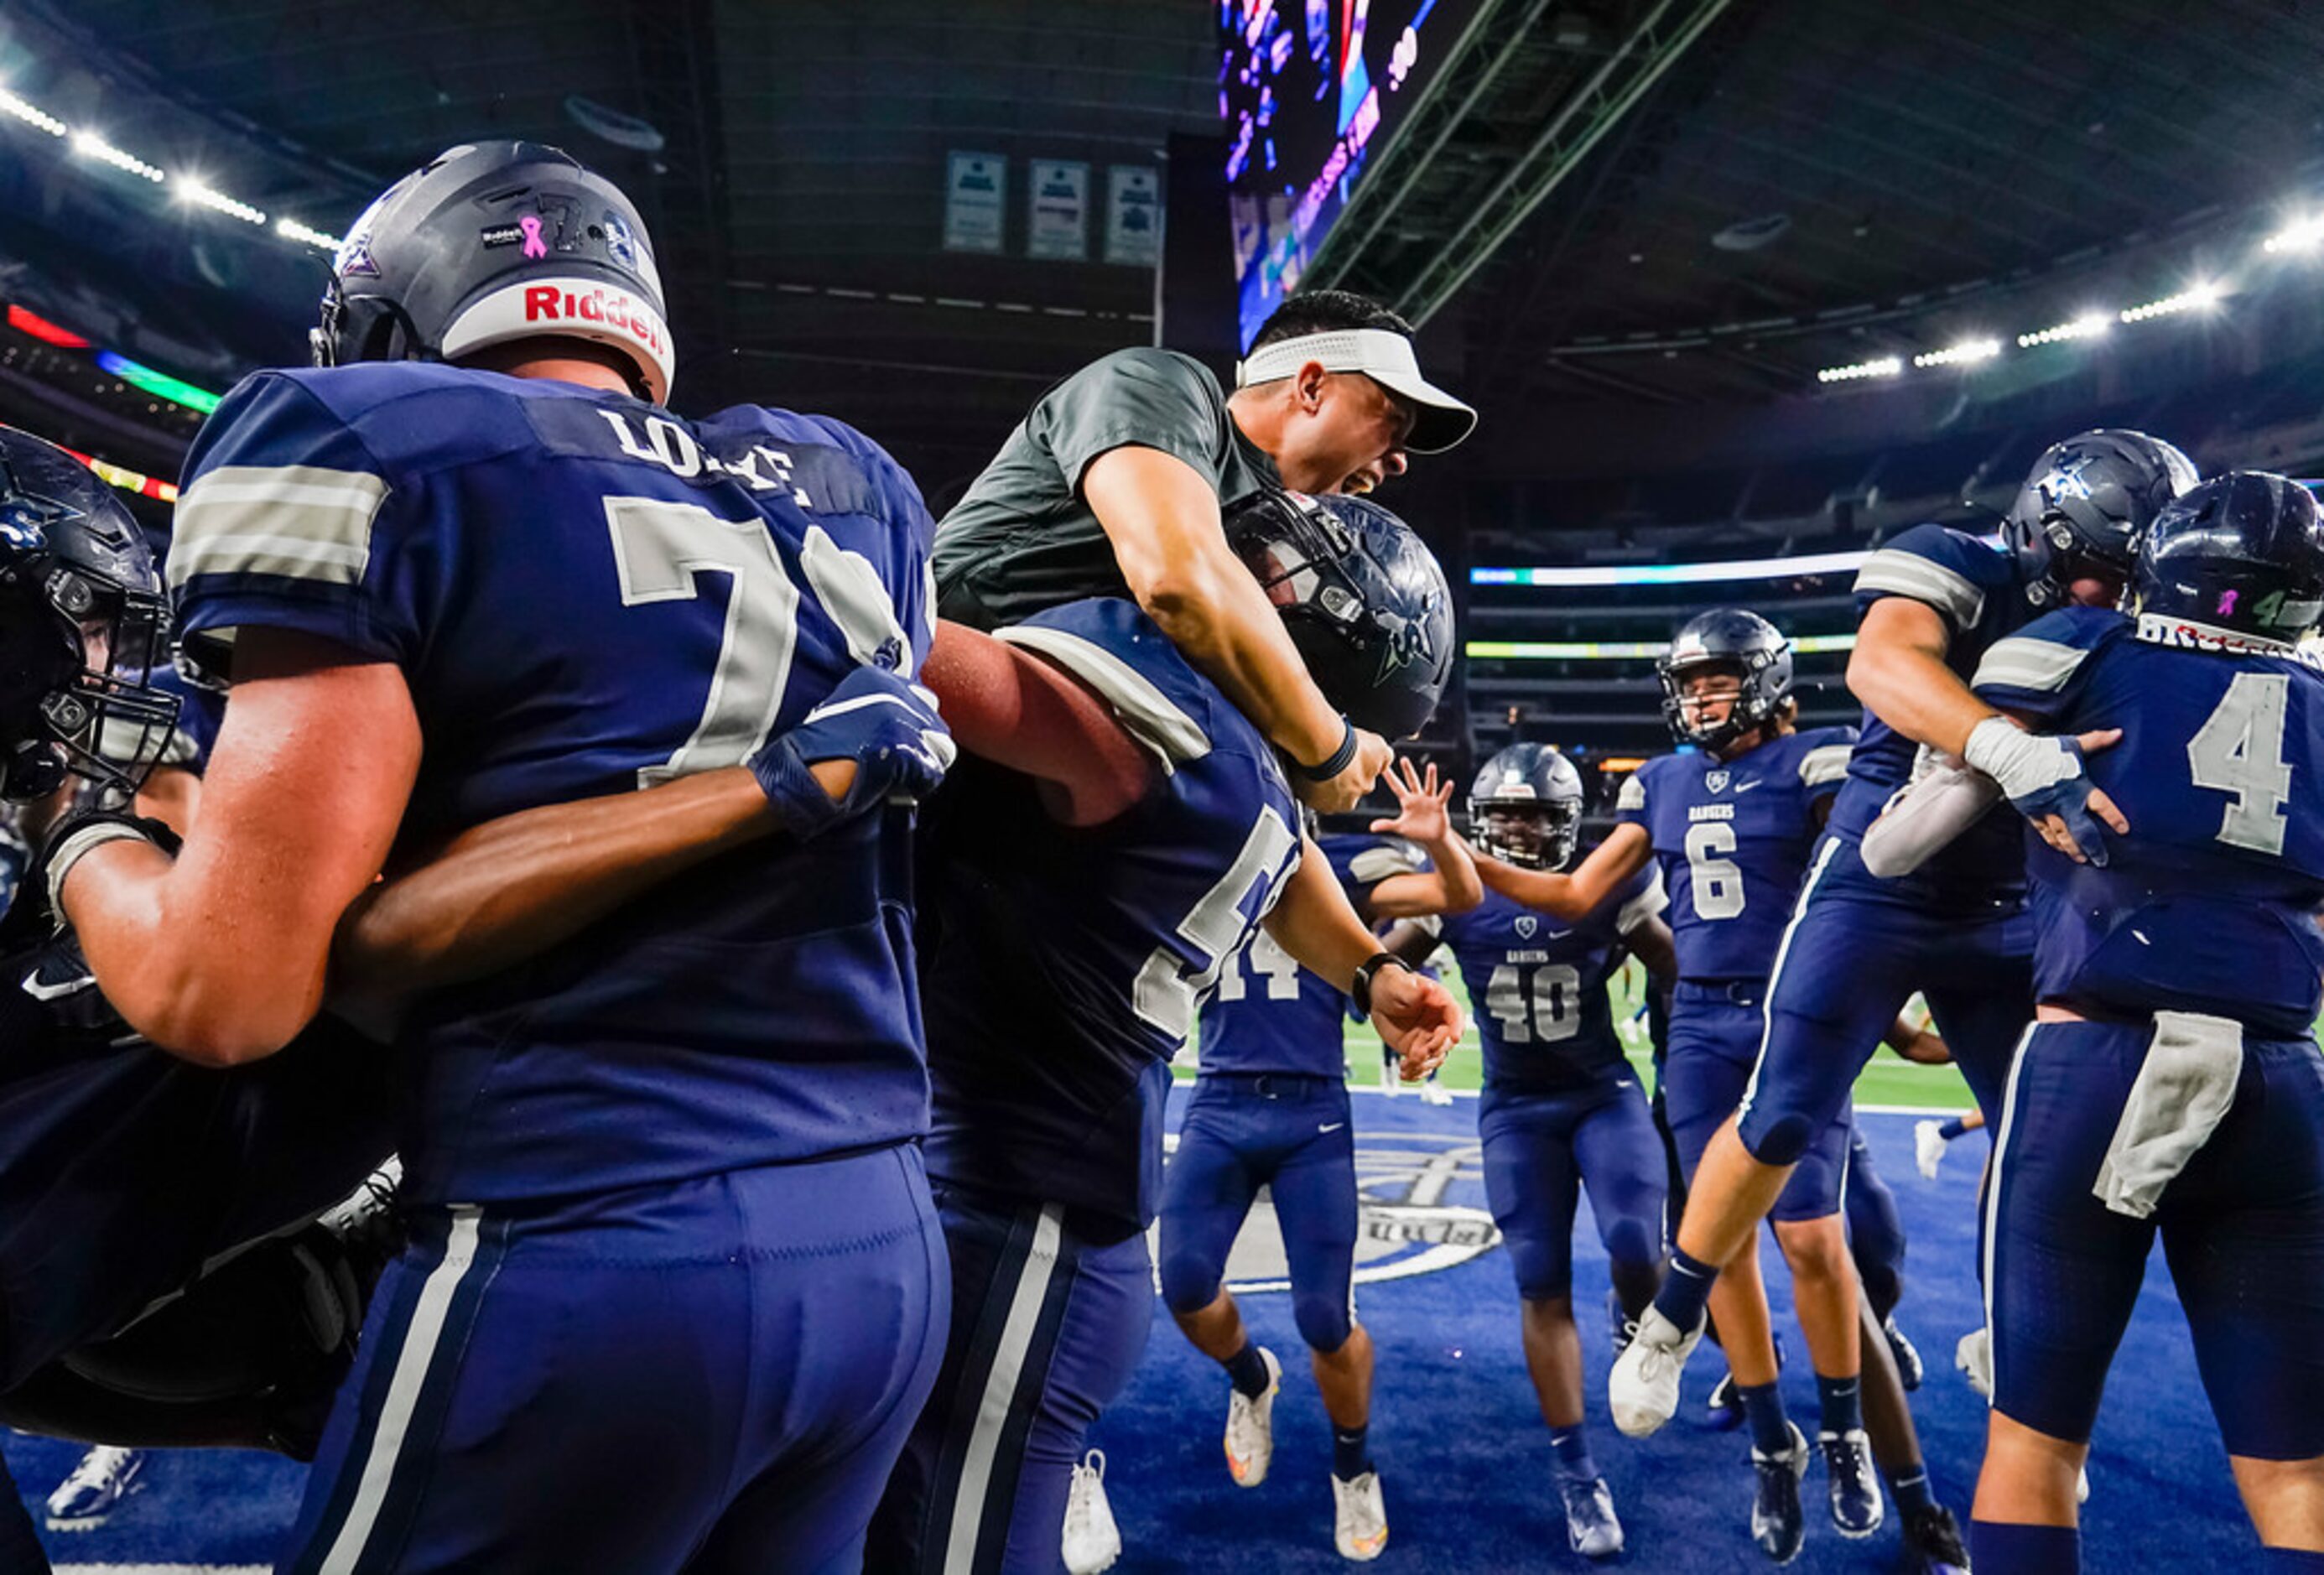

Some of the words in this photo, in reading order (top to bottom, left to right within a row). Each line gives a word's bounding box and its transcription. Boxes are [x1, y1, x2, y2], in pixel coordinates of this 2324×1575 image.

[2253, 590, 2285, 626] 4
[2187, 672, 2293, 856] 4
[1685, 822, 1745, 920] 6
[1485, 964, 1580, 1042] 40
